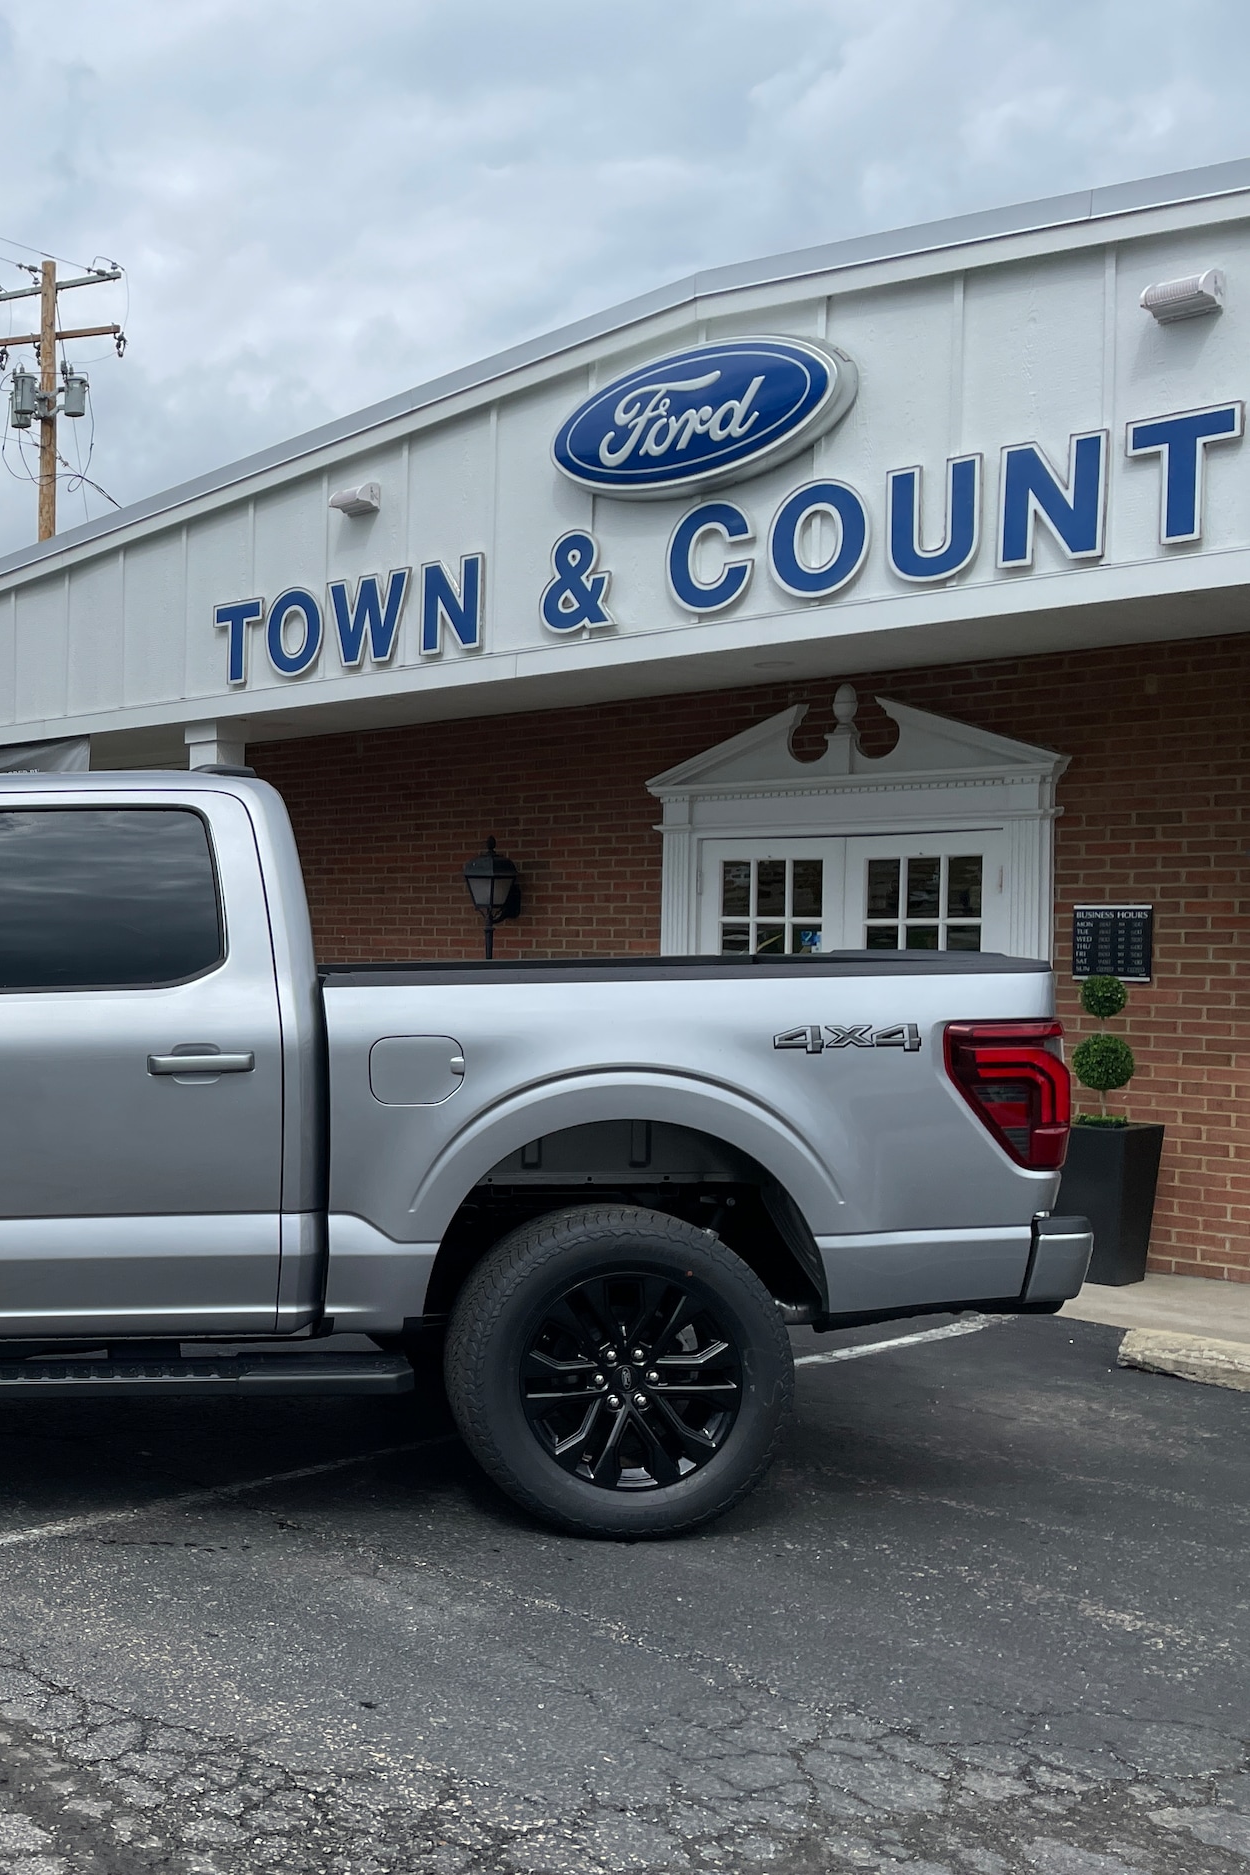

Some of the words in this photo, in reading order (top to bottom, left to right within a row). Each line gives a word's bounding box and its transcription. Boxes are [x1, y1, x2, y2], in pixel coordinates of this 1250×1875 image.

[599, 370, 766, 467] Ford
[213, 552, 485, 685] TOWN
[539, 528, 618, 634] &
[666, 401, 1245, 614] COUNT
[1076, 911, 1114, 919] BUSINESS
[1117, 911, 1148, 919] HOURS
